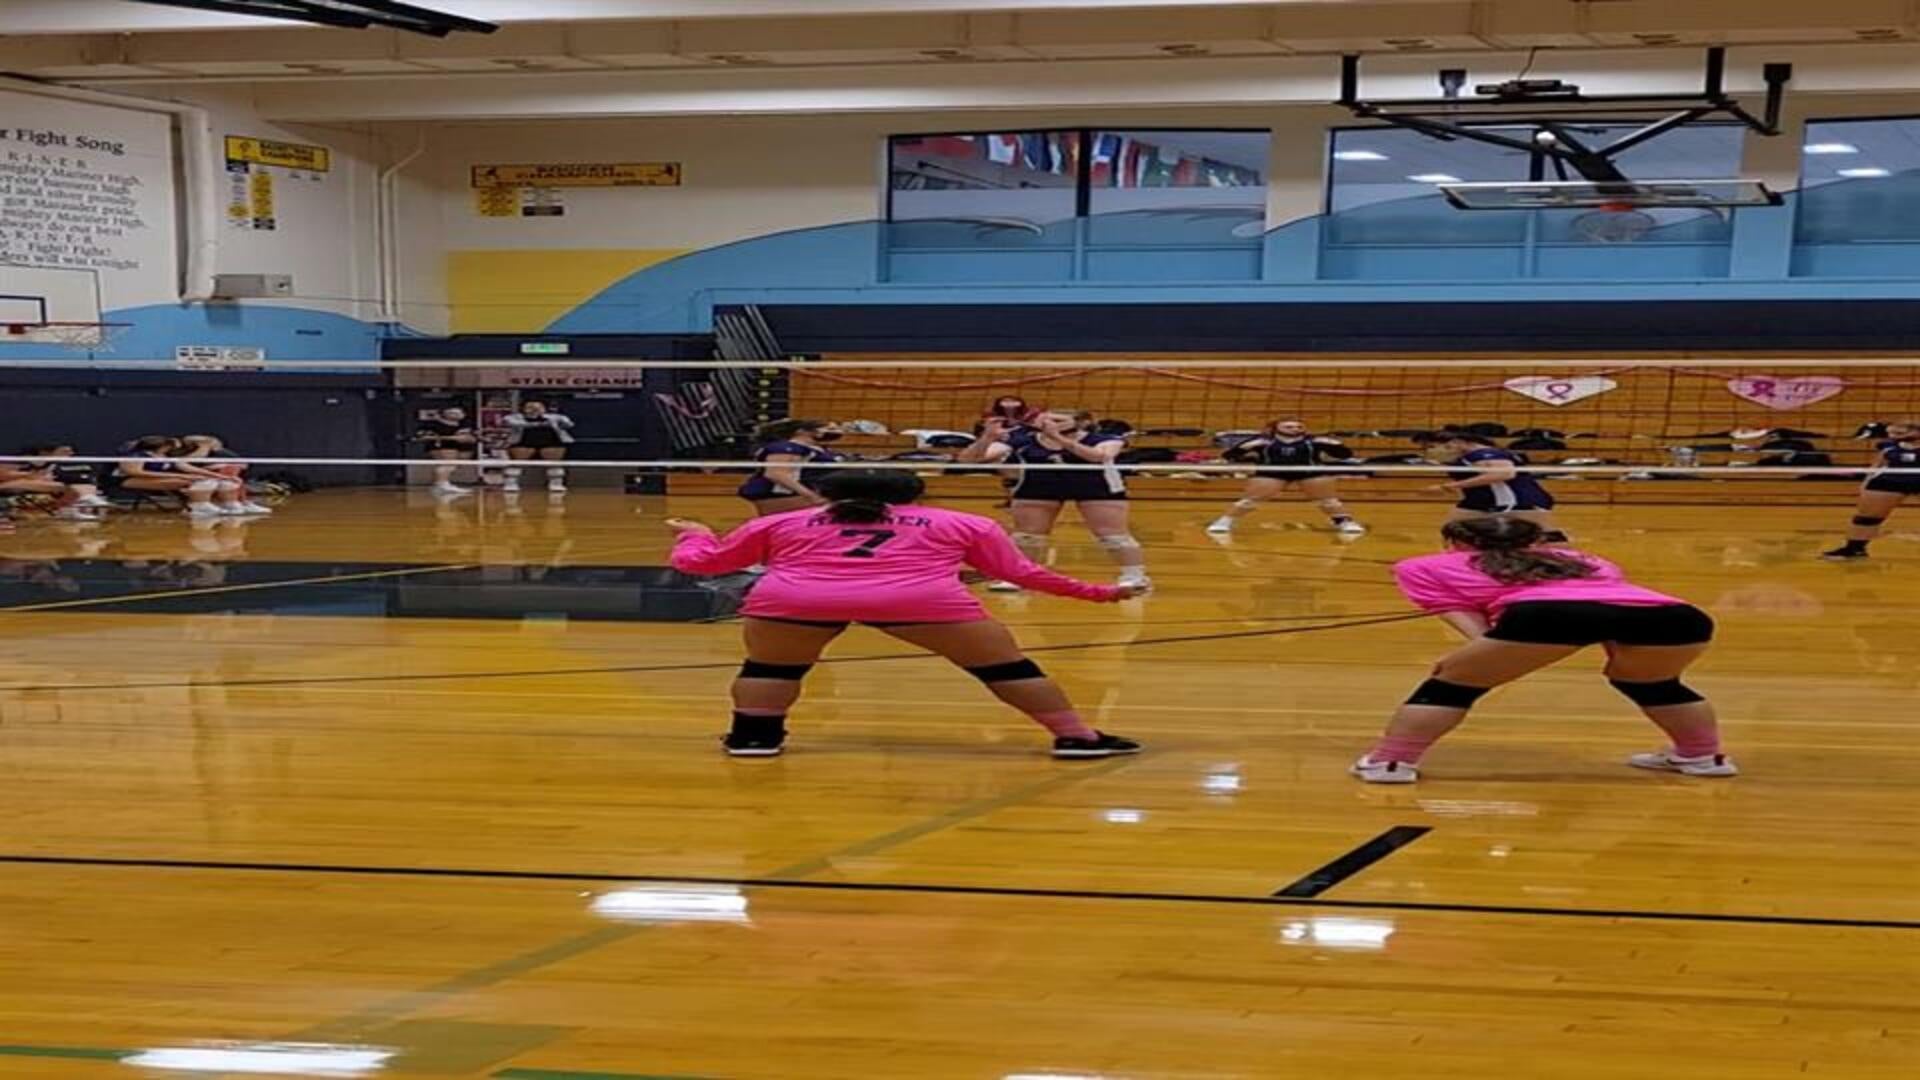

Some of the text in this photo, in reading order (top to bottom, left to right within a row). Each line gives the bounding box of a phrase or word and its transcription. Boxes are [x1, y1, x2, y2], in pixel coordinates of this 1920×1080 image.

[16, 129, 67, 147] Fight
[76, 136, 125, 155] Song
[511, 377, 565, 385] STATE
[840, 529, 896, 558] 7
